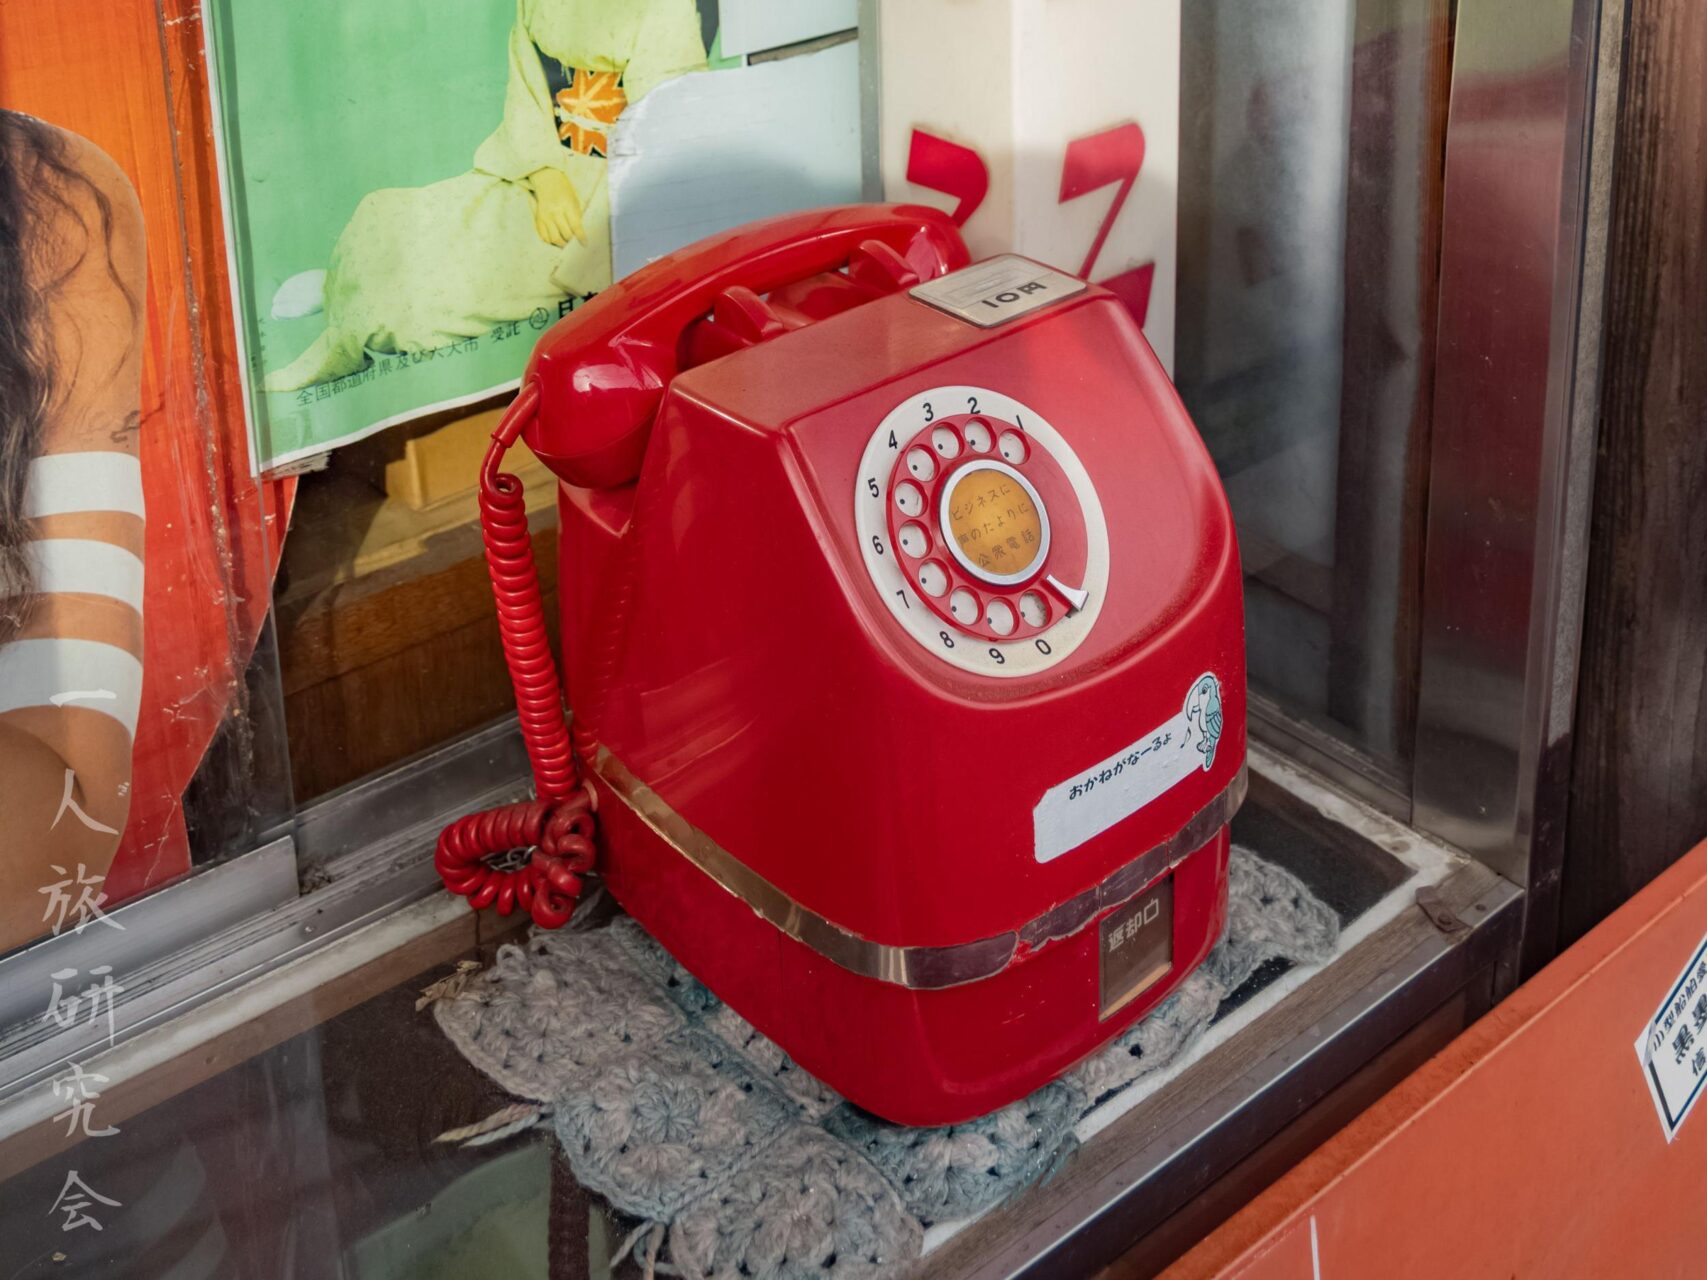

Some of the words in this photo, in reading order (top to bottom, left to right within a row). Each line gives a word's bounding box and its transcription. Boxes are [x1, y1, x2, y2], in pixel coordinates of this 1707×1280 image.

[981, 281, 1047, 308] 10円
[922, 402, 934, 422] 3
[967, 396, 981, 414] 2
[1015, 414, 1024, 431] 1
[888, 429, 898, 449] 4
[867, 477, 879, 498] 5
[872, 535, 884, 555] 6
[896, 589, 910, 609] 7
[939, 631, 955, 648] 8
[1035, 639, 1052, 656] 0
[988, 647, 1006, 665] 9
[1069, 732, 1173, 801] おかねがなーるよ
[1108, 897, 1160, 953] 返却口
